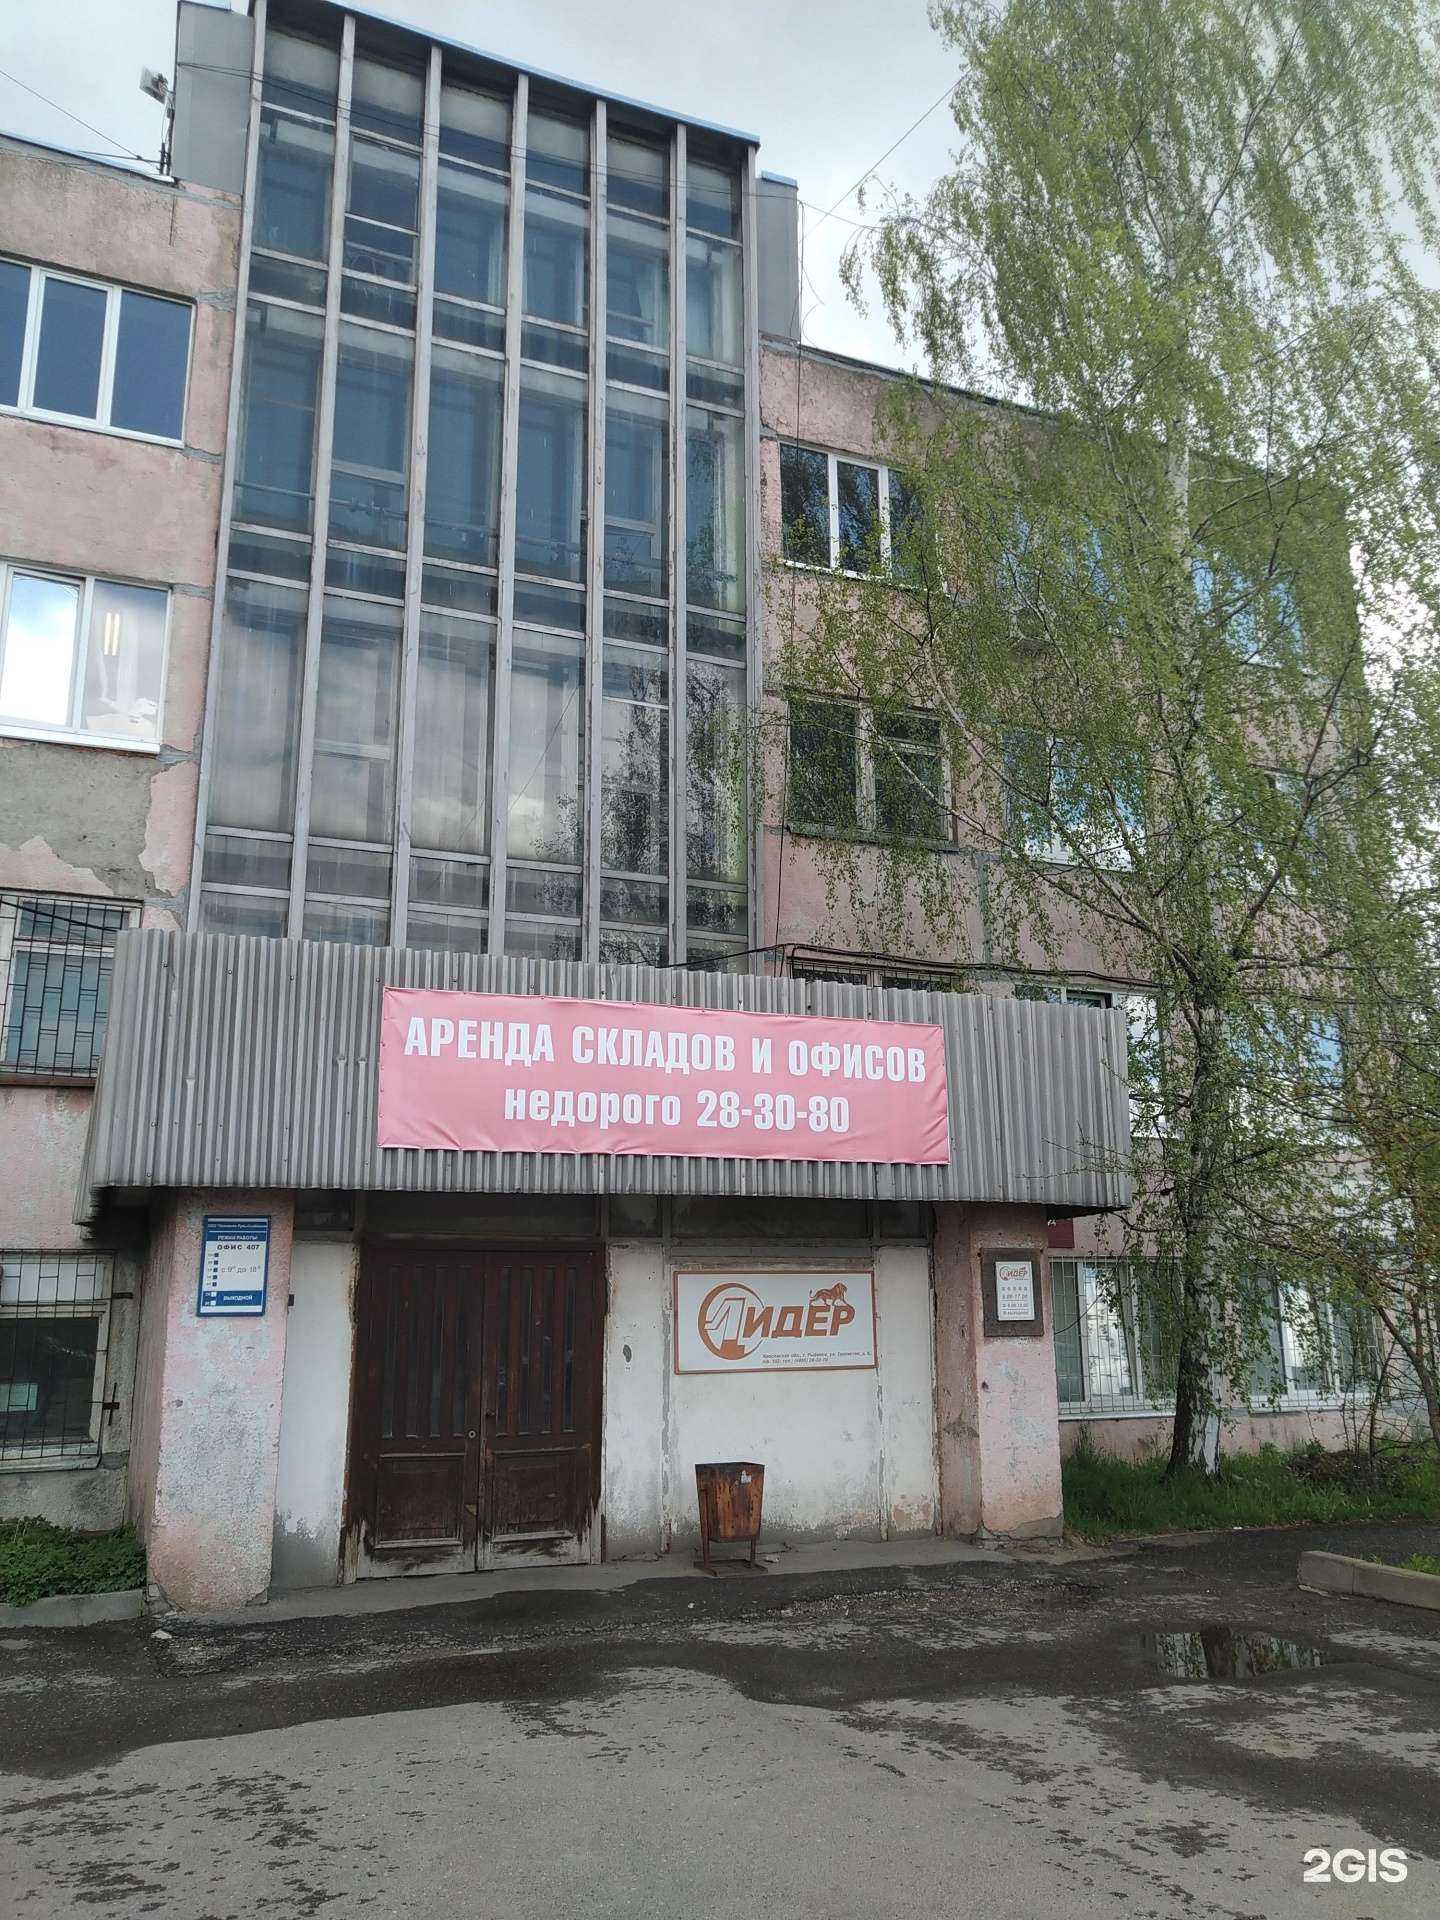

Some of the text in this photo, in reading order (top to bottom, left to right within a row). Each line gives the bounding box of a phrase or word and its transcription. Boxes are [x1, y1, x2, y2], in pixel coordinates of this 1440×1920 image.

[403, 1016, 926, 1082] АРЕНДА СКЛАДОВ И ОФИСОВ
[504, 1088, 850, 1133] недорого 28-30-80
[699, 1296, 856, 1357] ЛИДЕР
